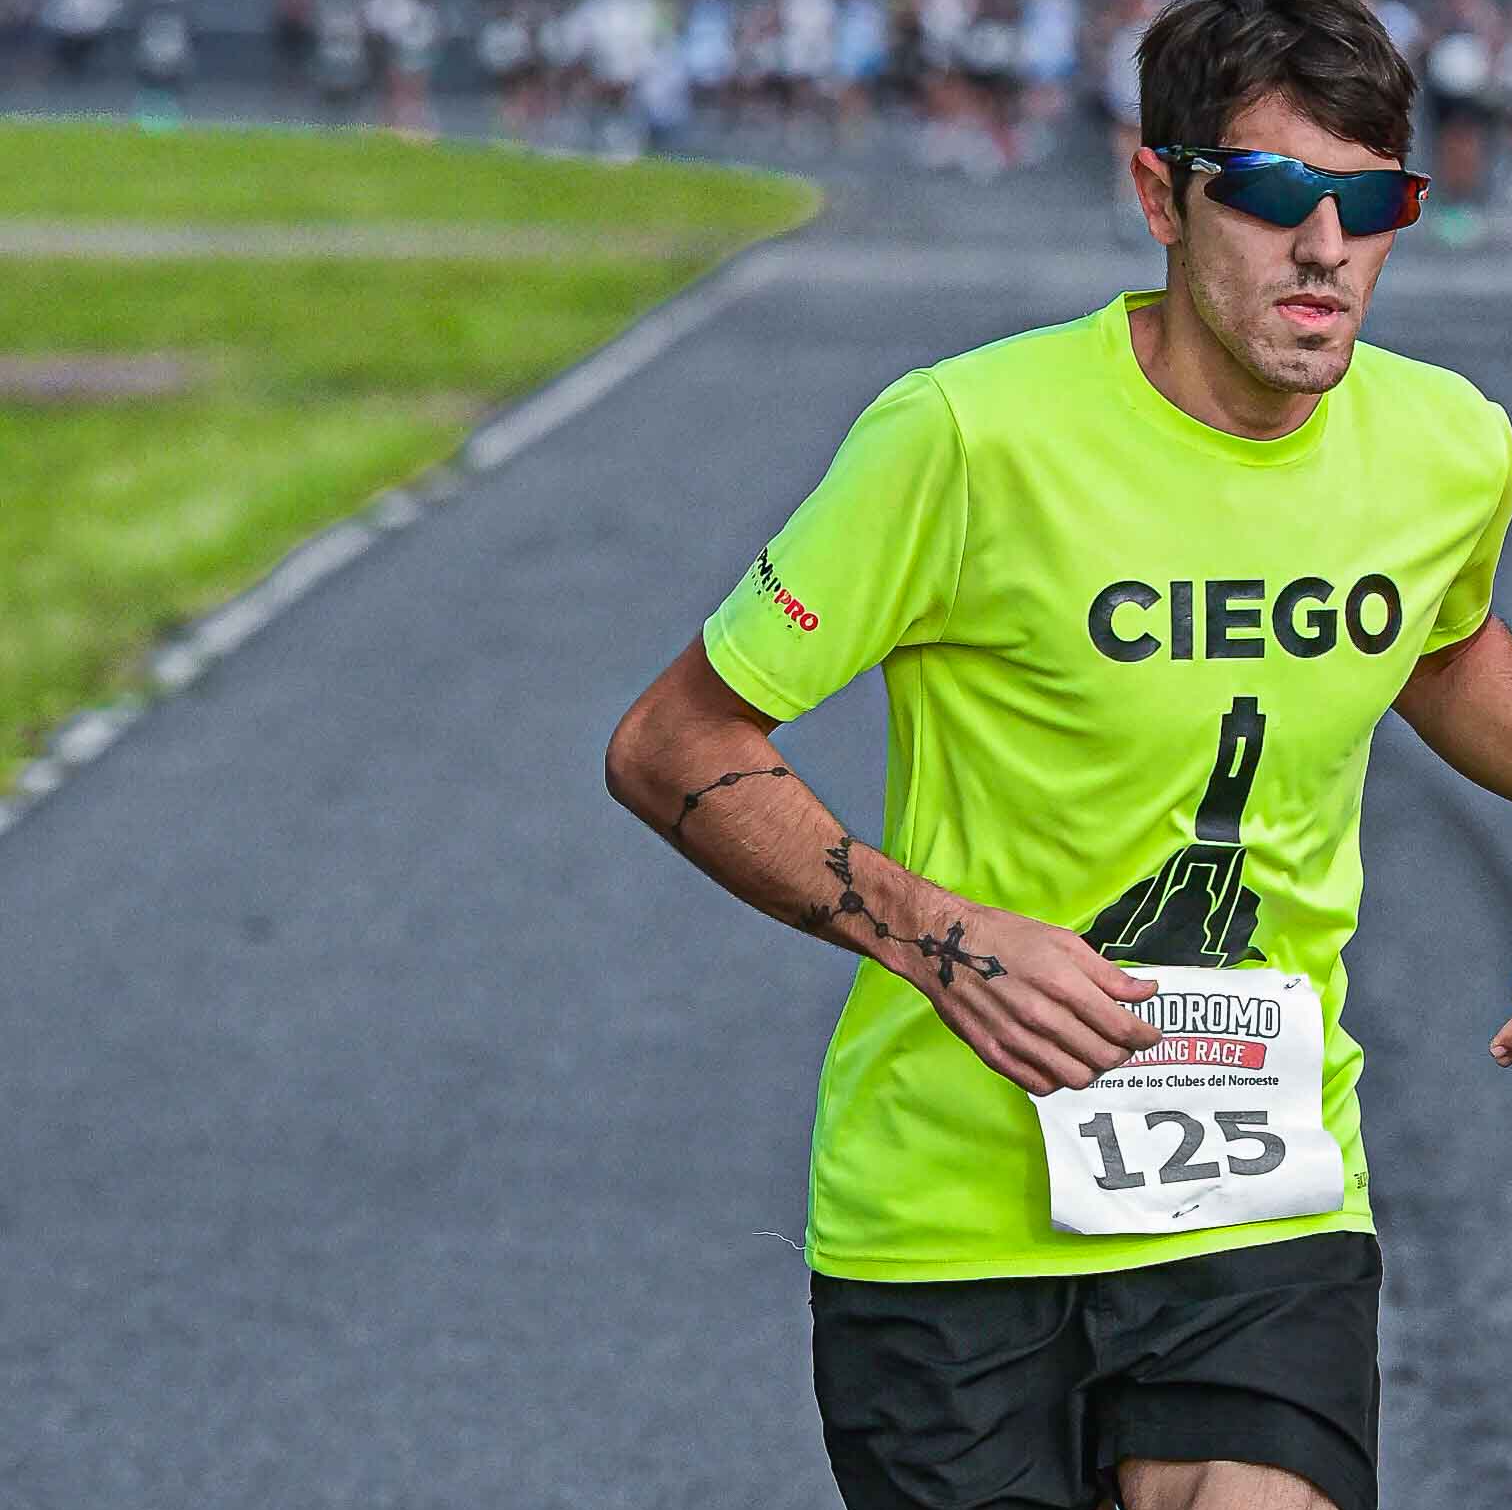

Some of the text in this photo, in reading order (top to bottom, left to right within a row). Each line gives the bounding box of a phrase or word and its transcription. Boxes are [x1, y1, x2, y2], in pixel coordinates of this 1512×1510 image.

[1088, 573, 1403, 662] CIEGO
[1195, 1041, 1246, 1065] RACE
[1088, 1075, 1279, 1089] arrera de los Clubes del Noroeste
[1078, 1110, 1287, 1191] 125
